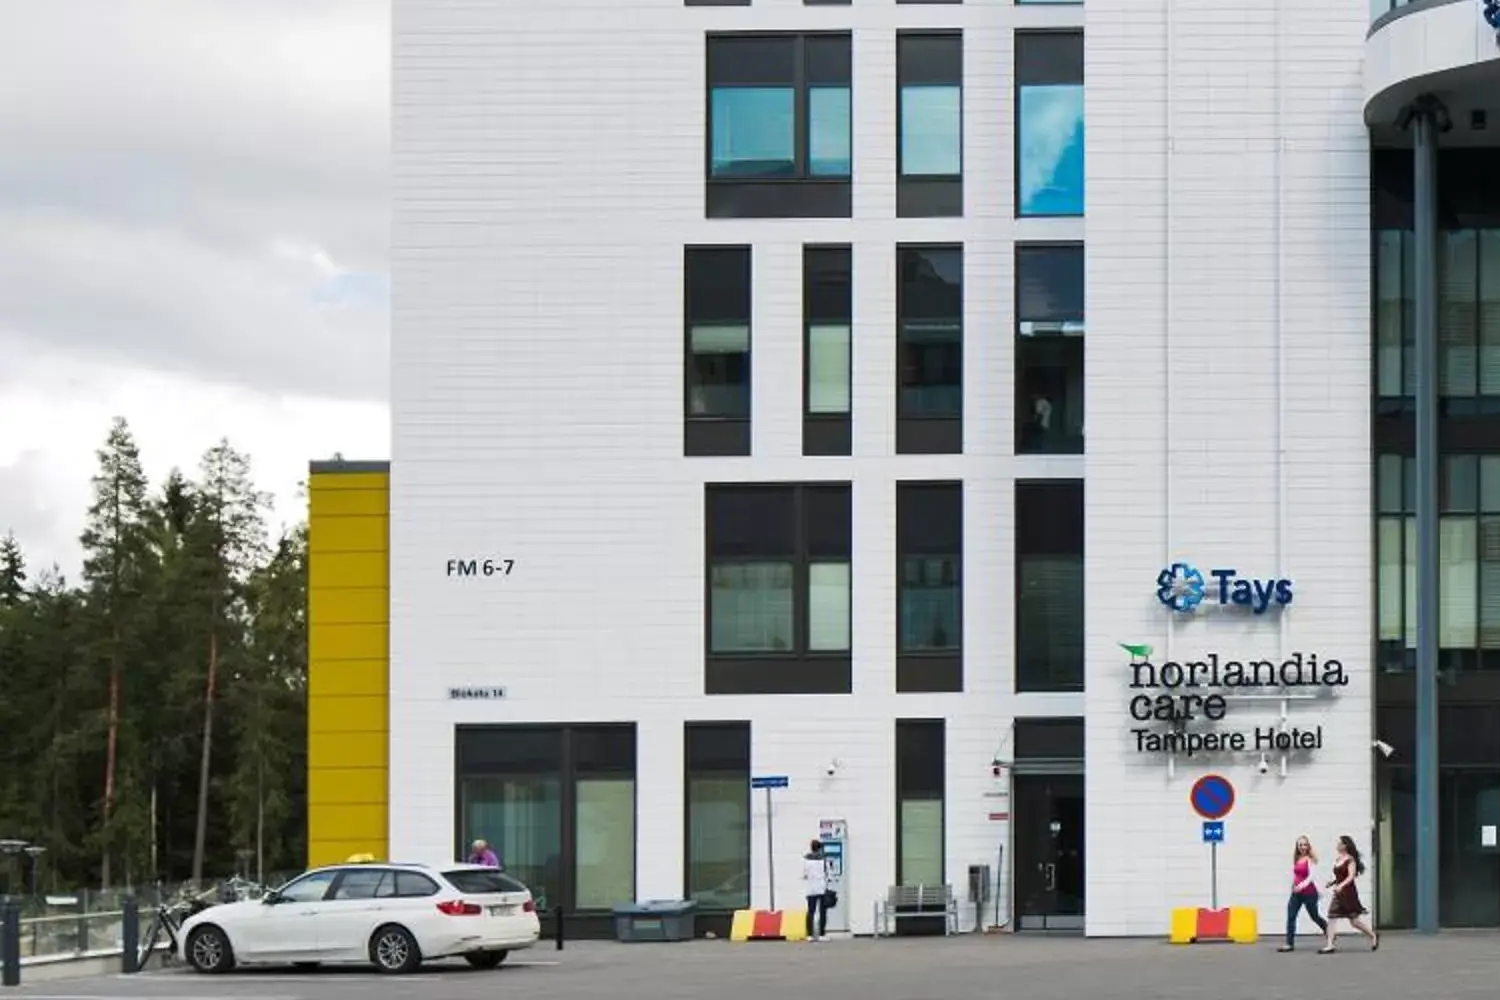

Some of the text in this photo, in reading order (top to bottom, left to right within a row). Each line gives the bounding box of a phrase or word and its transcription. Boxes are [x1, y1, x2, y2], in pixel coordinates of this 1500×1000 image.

[447, 559, 515, 577] FM 6-7
[1211, 569, 1293, 614] Tays
[1129, 653, 1349, 688] norlandia
[1130, 693, 1227, 722] care
[1131, 726, 1322, 756] Tampere Hotel
